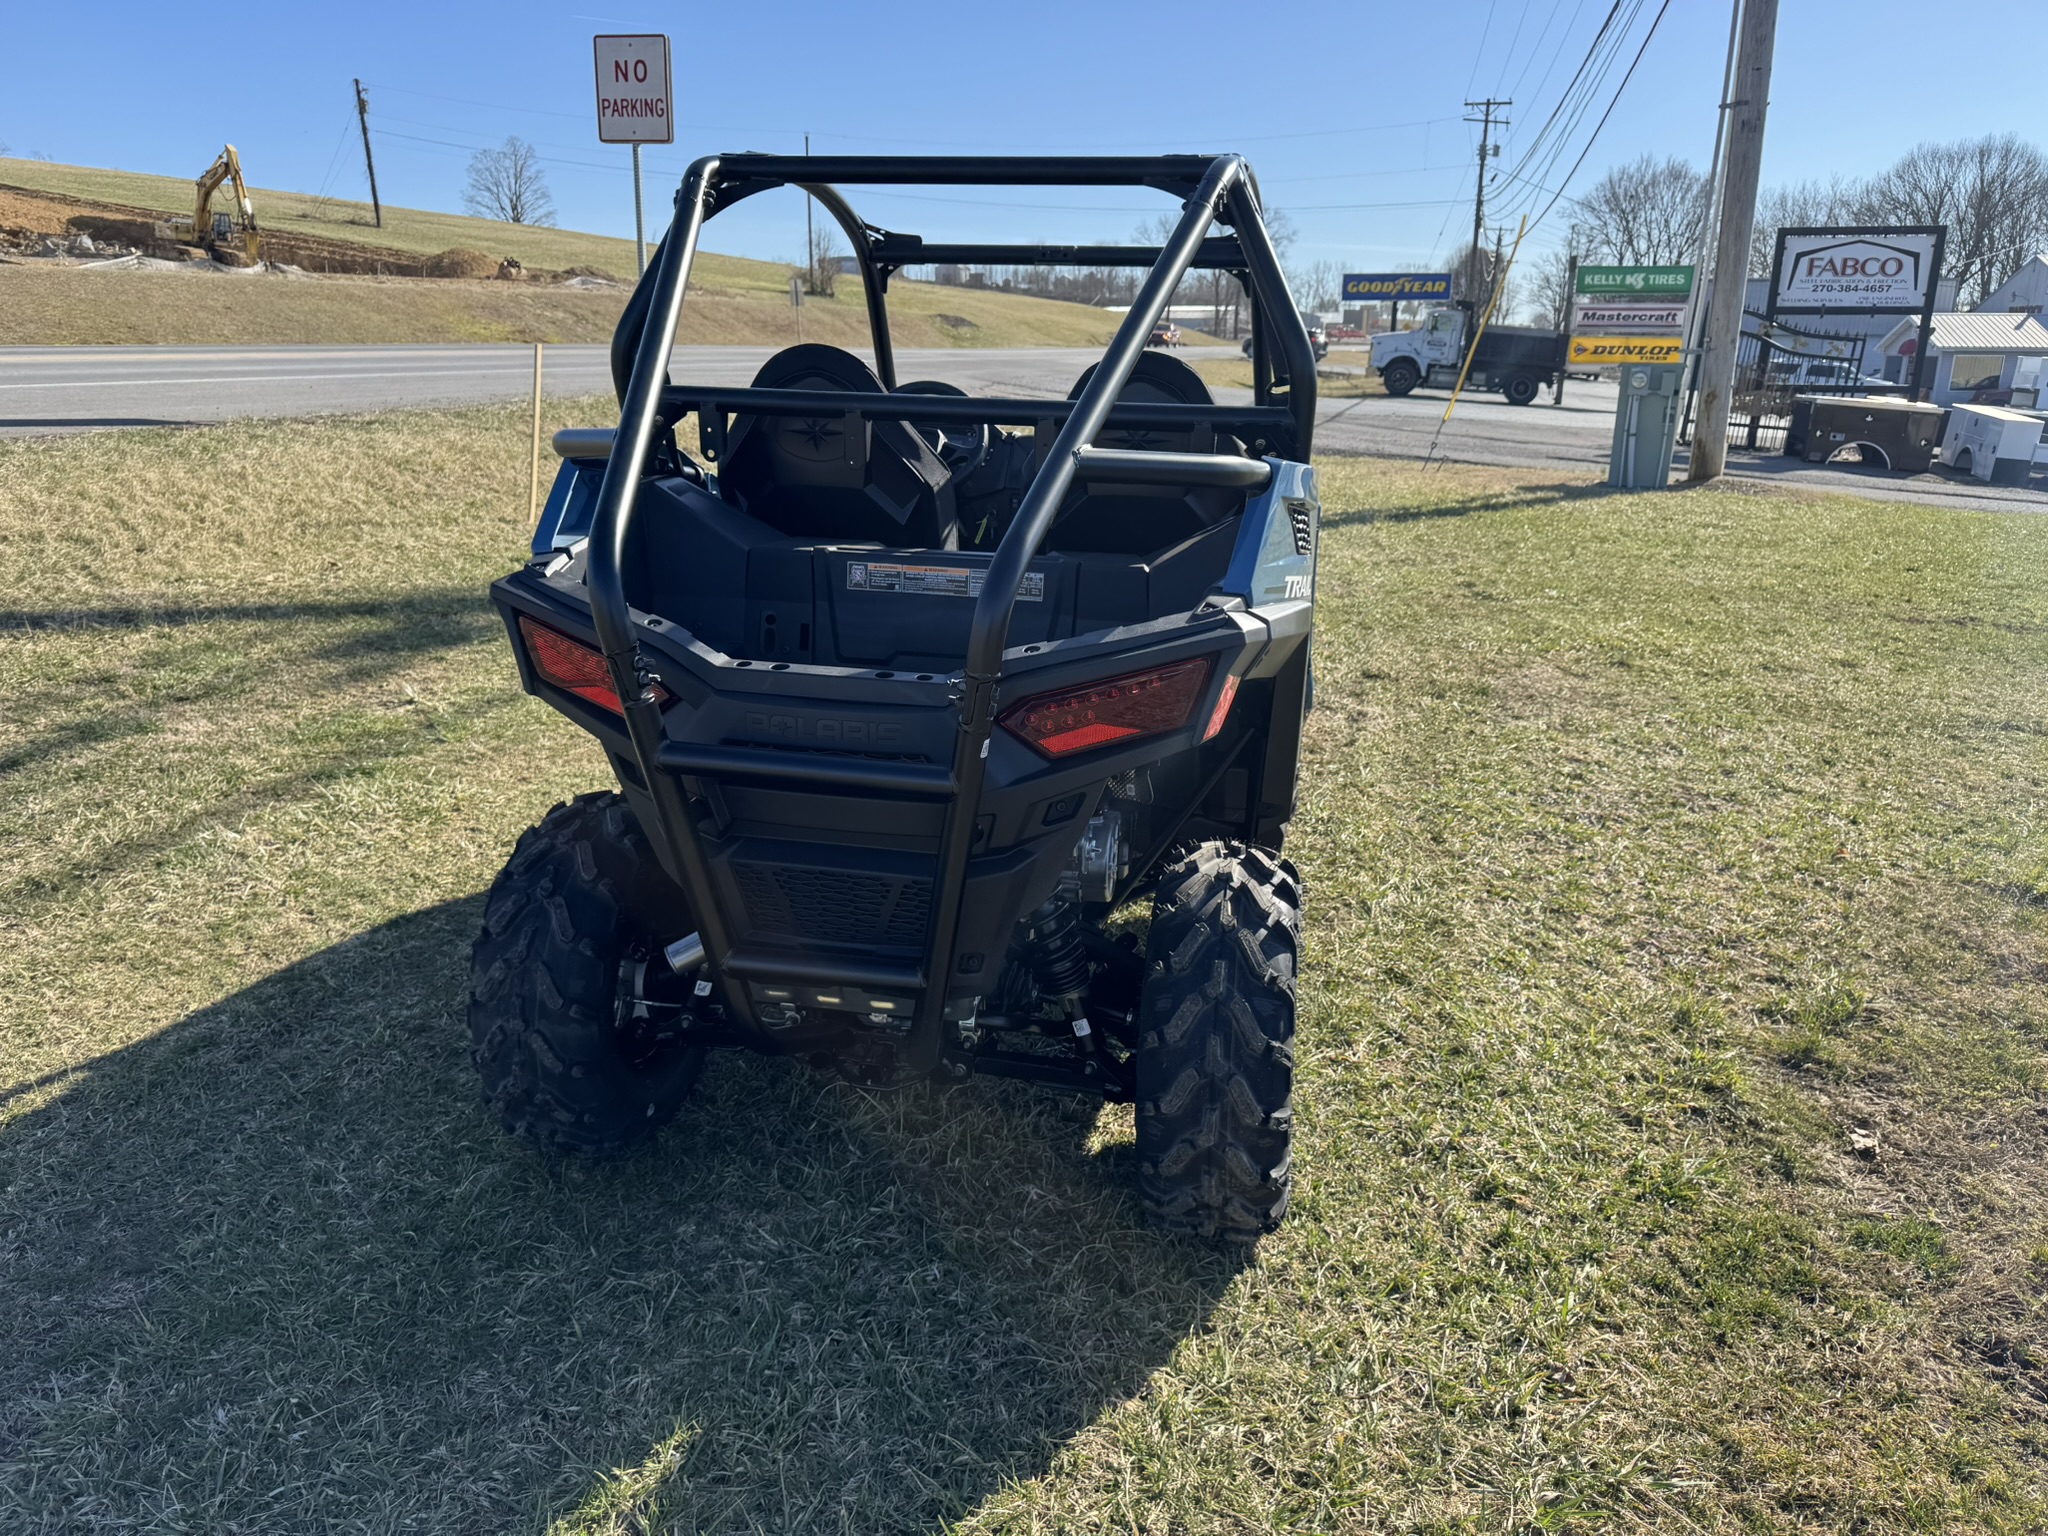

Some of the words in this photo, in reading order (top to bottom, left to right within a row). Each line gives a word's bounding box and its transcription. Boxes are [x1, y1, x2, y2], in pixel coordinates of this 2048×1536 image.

[614, 59, 647, 83] NO
[601, 98, 665, 118] PARKING
[1806, 256, 1903, 278] FABCO
[1347, 279, 1447, 294] GOODYEAR
[1584, 274, 1623, 285] KELLY
[1648, 274, 1685, 285] TIRES
[1811, 284, 1893, 293] 270-384-4657
[1582, 312, 1678, 322] Mastercraft
[1590, 345, 1679, 356] DUNLOP
[746, 711, 903, 745] POLARIS
